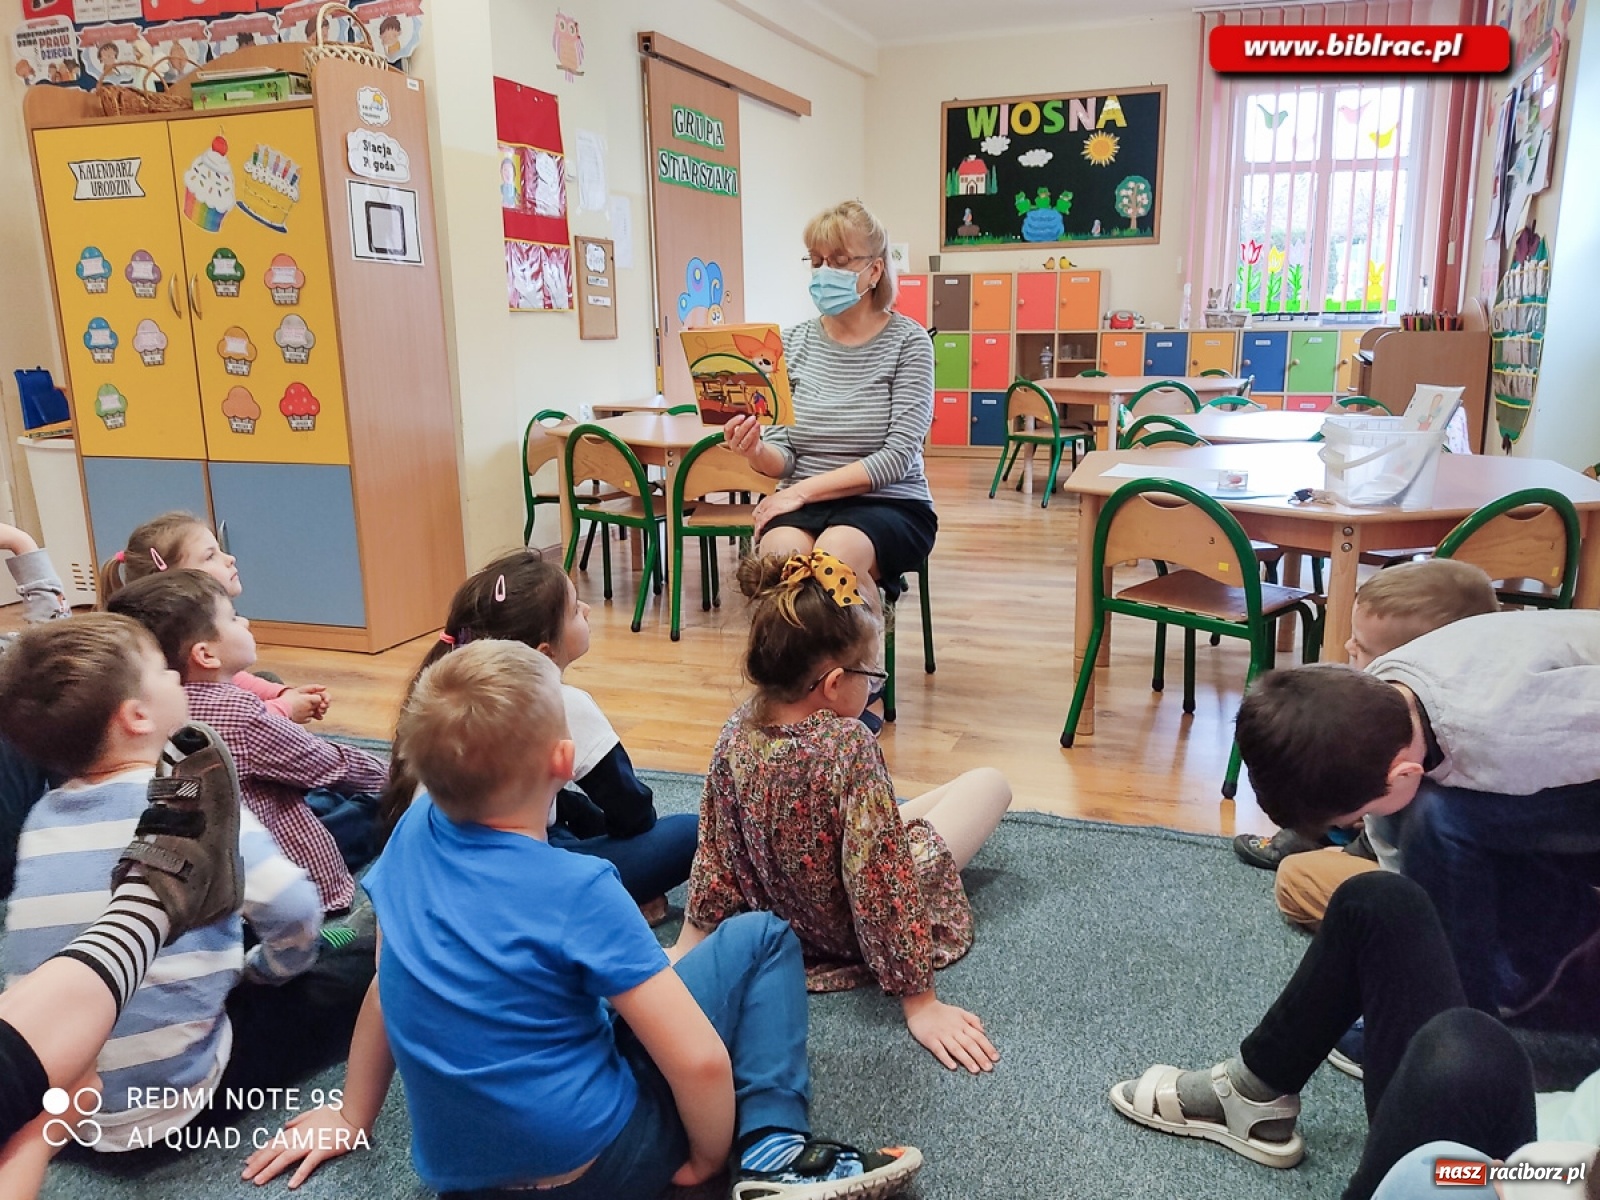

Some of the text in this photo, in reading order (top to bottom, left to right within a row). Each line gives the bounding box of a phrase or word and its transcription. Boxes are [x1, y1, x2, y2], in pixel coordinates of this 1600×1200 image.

[39, 33, 70, 48] PRAW
[967, 95, 1128, 139] WIOSNA
[675, 110, 724, 145] GRUPA
[78, 161, 134, 180] KALENDARZ
[363, 156, 395, 172] Pgoda
[660, 152, 737, 193] STARSZAKI
[90, 179, 132, 196] URODZIN
